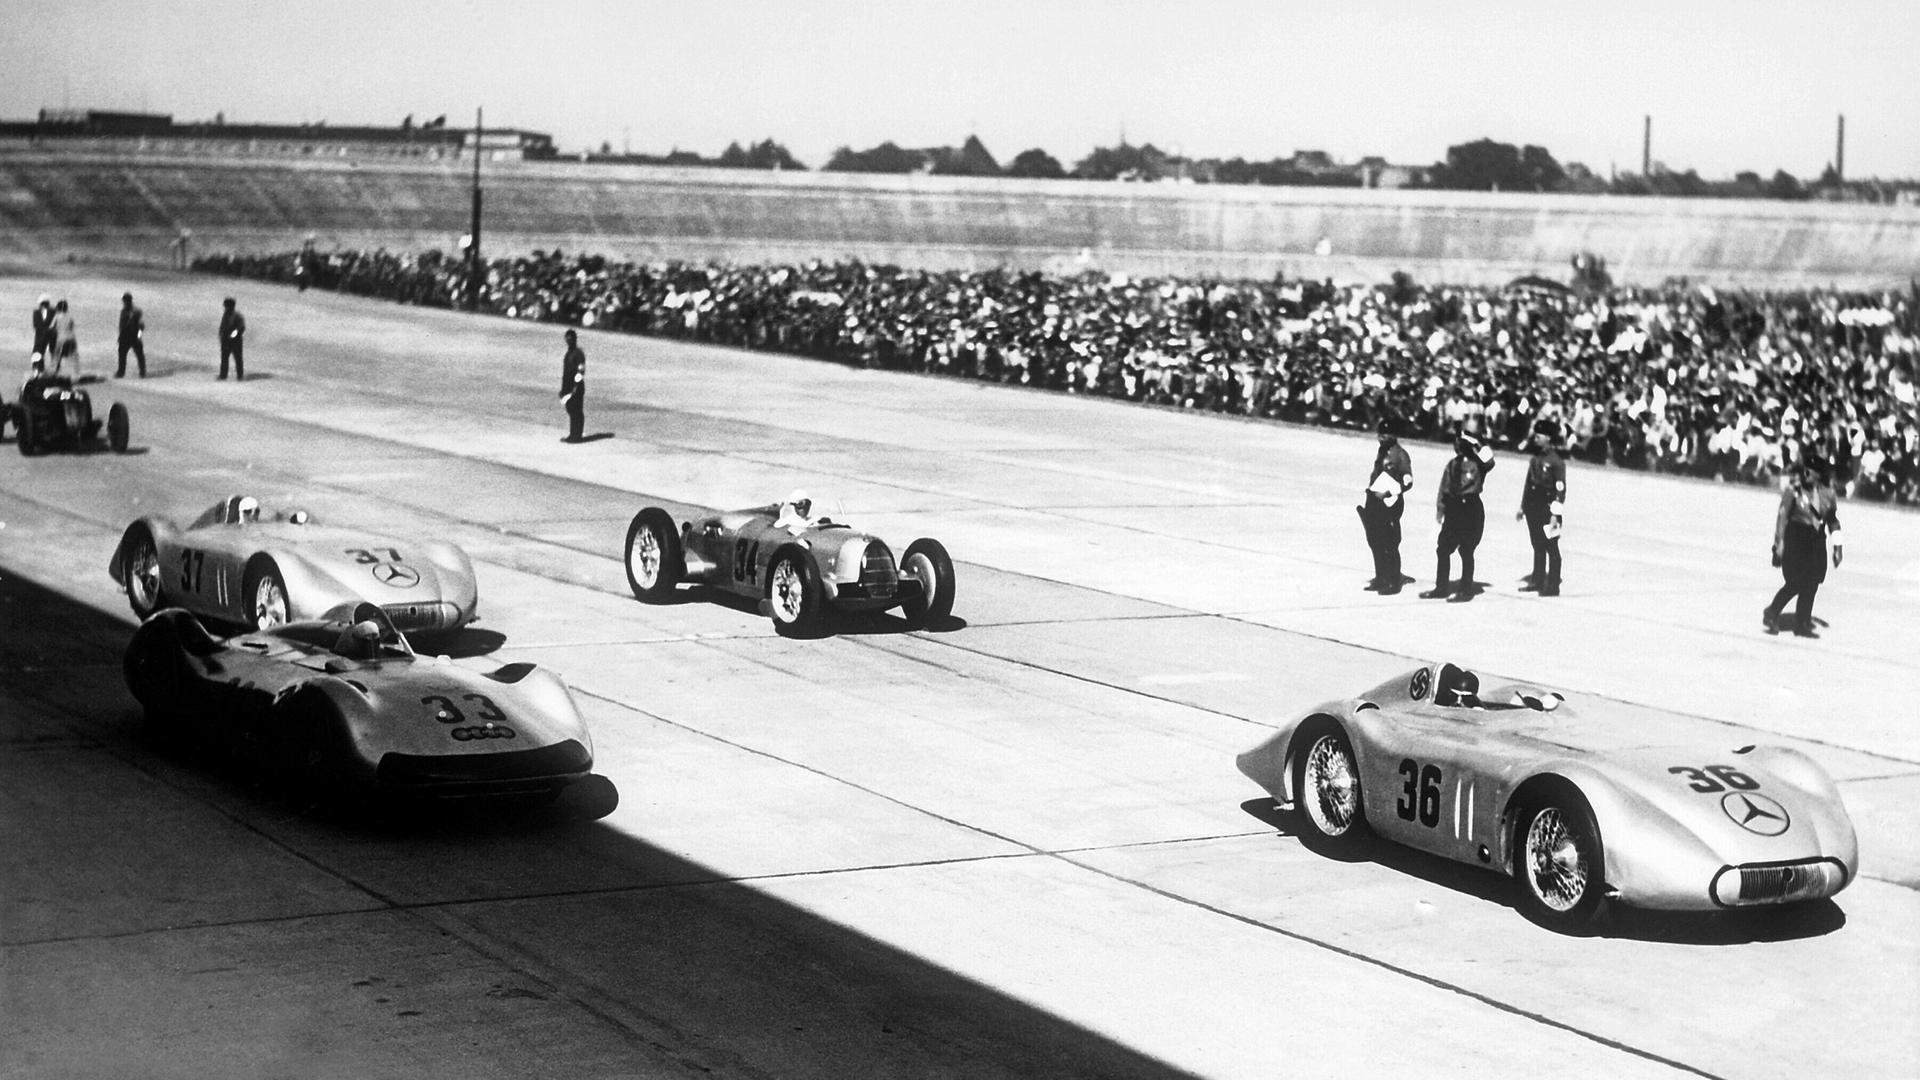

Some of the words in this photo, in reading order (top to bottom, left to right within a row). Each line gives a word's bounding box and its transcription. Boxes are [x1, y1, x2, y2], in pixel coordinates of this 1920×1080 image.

[181, 548, 205, 594] 37
[345, 548, 403, 564] 37
[734, 538, 760, 586] 34
[421, 693, 507, 724] 33
[1396, 758, 1442, 829] 36
[1668, 764, 1761, 794] 36
